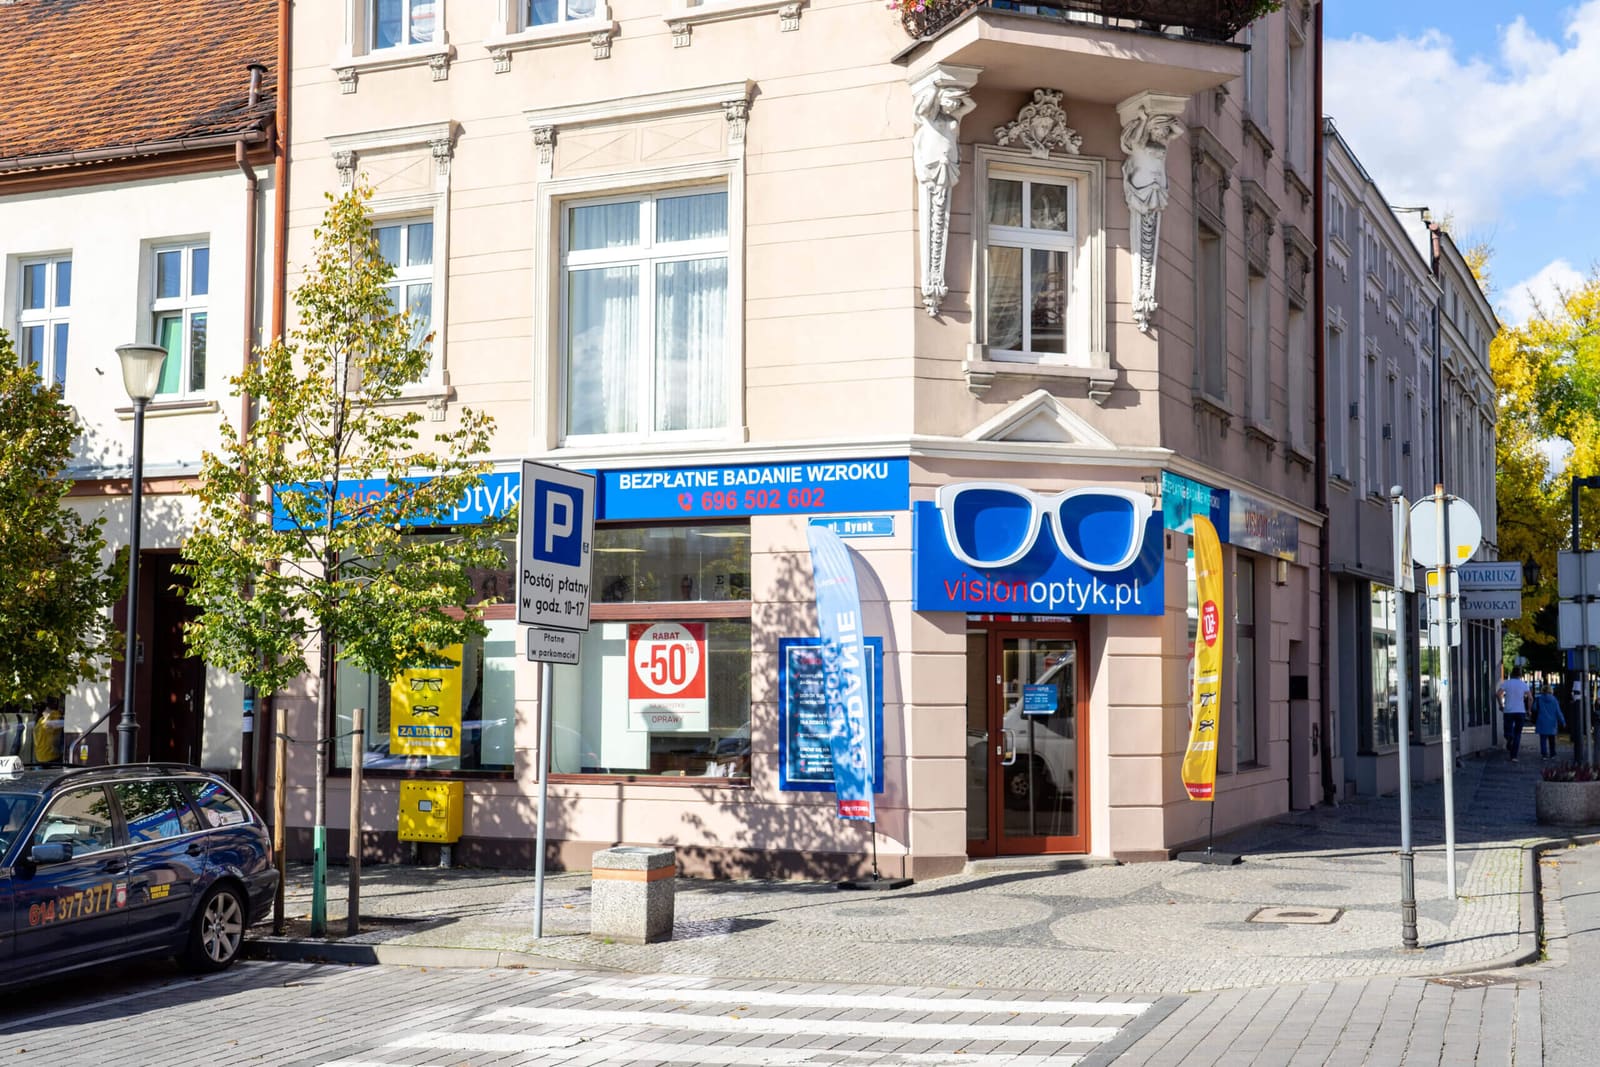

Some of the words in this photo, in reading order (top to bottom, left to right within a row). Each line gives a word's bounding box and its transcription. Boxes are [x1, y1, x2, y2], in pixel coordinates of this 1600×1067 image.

[619, 469, 719, 490] BEZPŁATNE
[723, 466, 802, 486] BADANIE
[806, 462, 889, 482] WZROKU
[340, 477, 520, 522] visiptyk
[701, 490, 737, 511] 696
[744, 489, 780, 509] 502
[788, 487, 825, 508] 602
[844, 520, 874, 534] Rynek
[523, 569, 554, 592] Postój
[558, 576, 589, 598] płatny
[1458, 569, 1517, 583] NOTARIUSZ
[943, 573, 1142, 612] visionoptyk.pl
[522, 597, 532, 609] w
[535, 597, 562, 615] godz.
[564, 600, 585, 616] 10-17
[543, 632, 565, 644] Płatne
[652, 631, 680, 641] RABAT
[651, 715, 684, 724] OPRAW
[400, 726, 413, 736] ZA
[415, 727, 451, 737] DARMO
